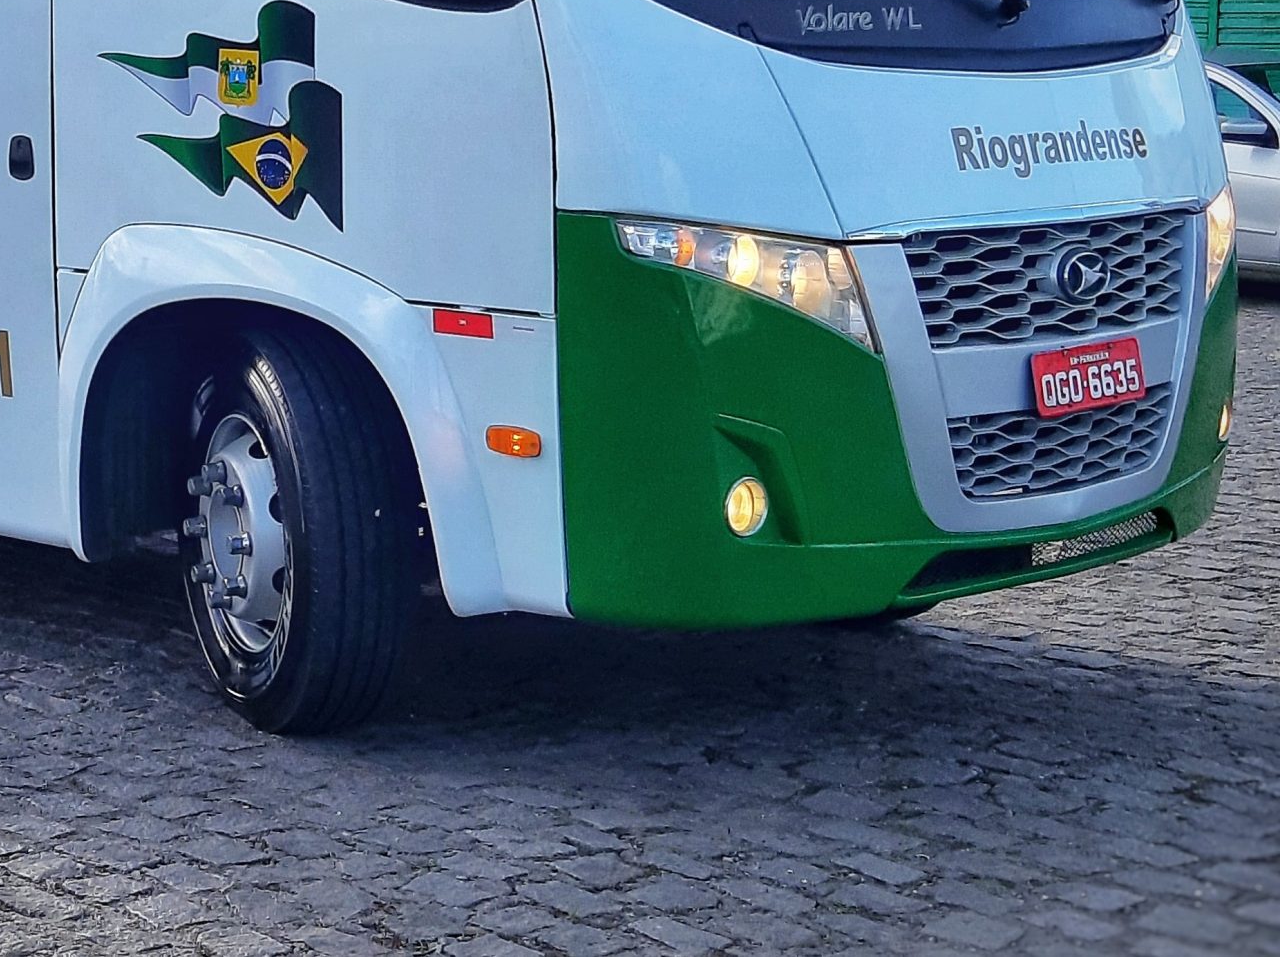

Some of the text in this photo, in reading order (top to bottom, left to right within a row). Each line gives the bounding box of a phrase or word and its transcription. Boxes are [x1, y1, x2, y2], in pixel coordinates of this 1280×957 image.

[795, 3, 923, 35] Volare WL
[950, 119, 1148, 178] Riograndense
